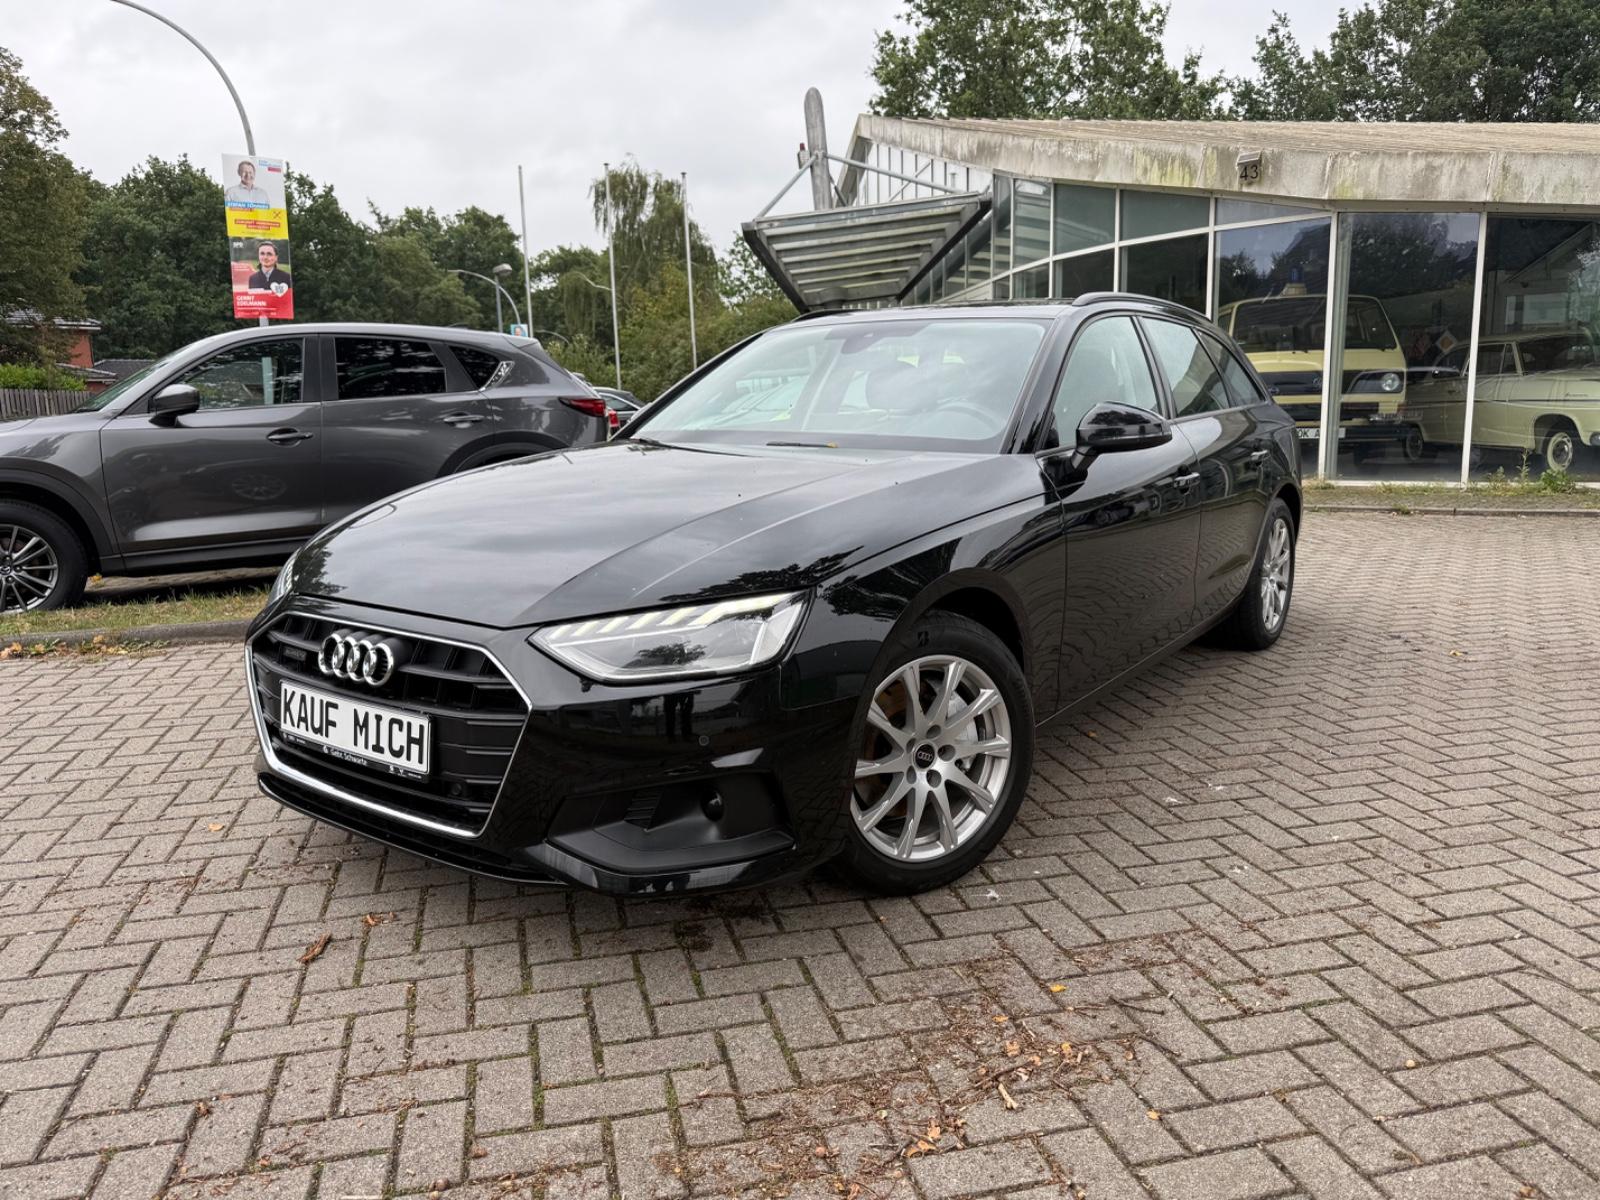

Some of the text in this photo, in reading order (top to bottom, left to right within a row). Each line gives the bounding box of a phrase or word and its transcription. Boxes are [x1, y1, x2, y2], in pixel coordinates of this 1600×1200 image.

[1240, 164, 1259, 181] 43
[283, 687, 425, 765] KAUF MICH
